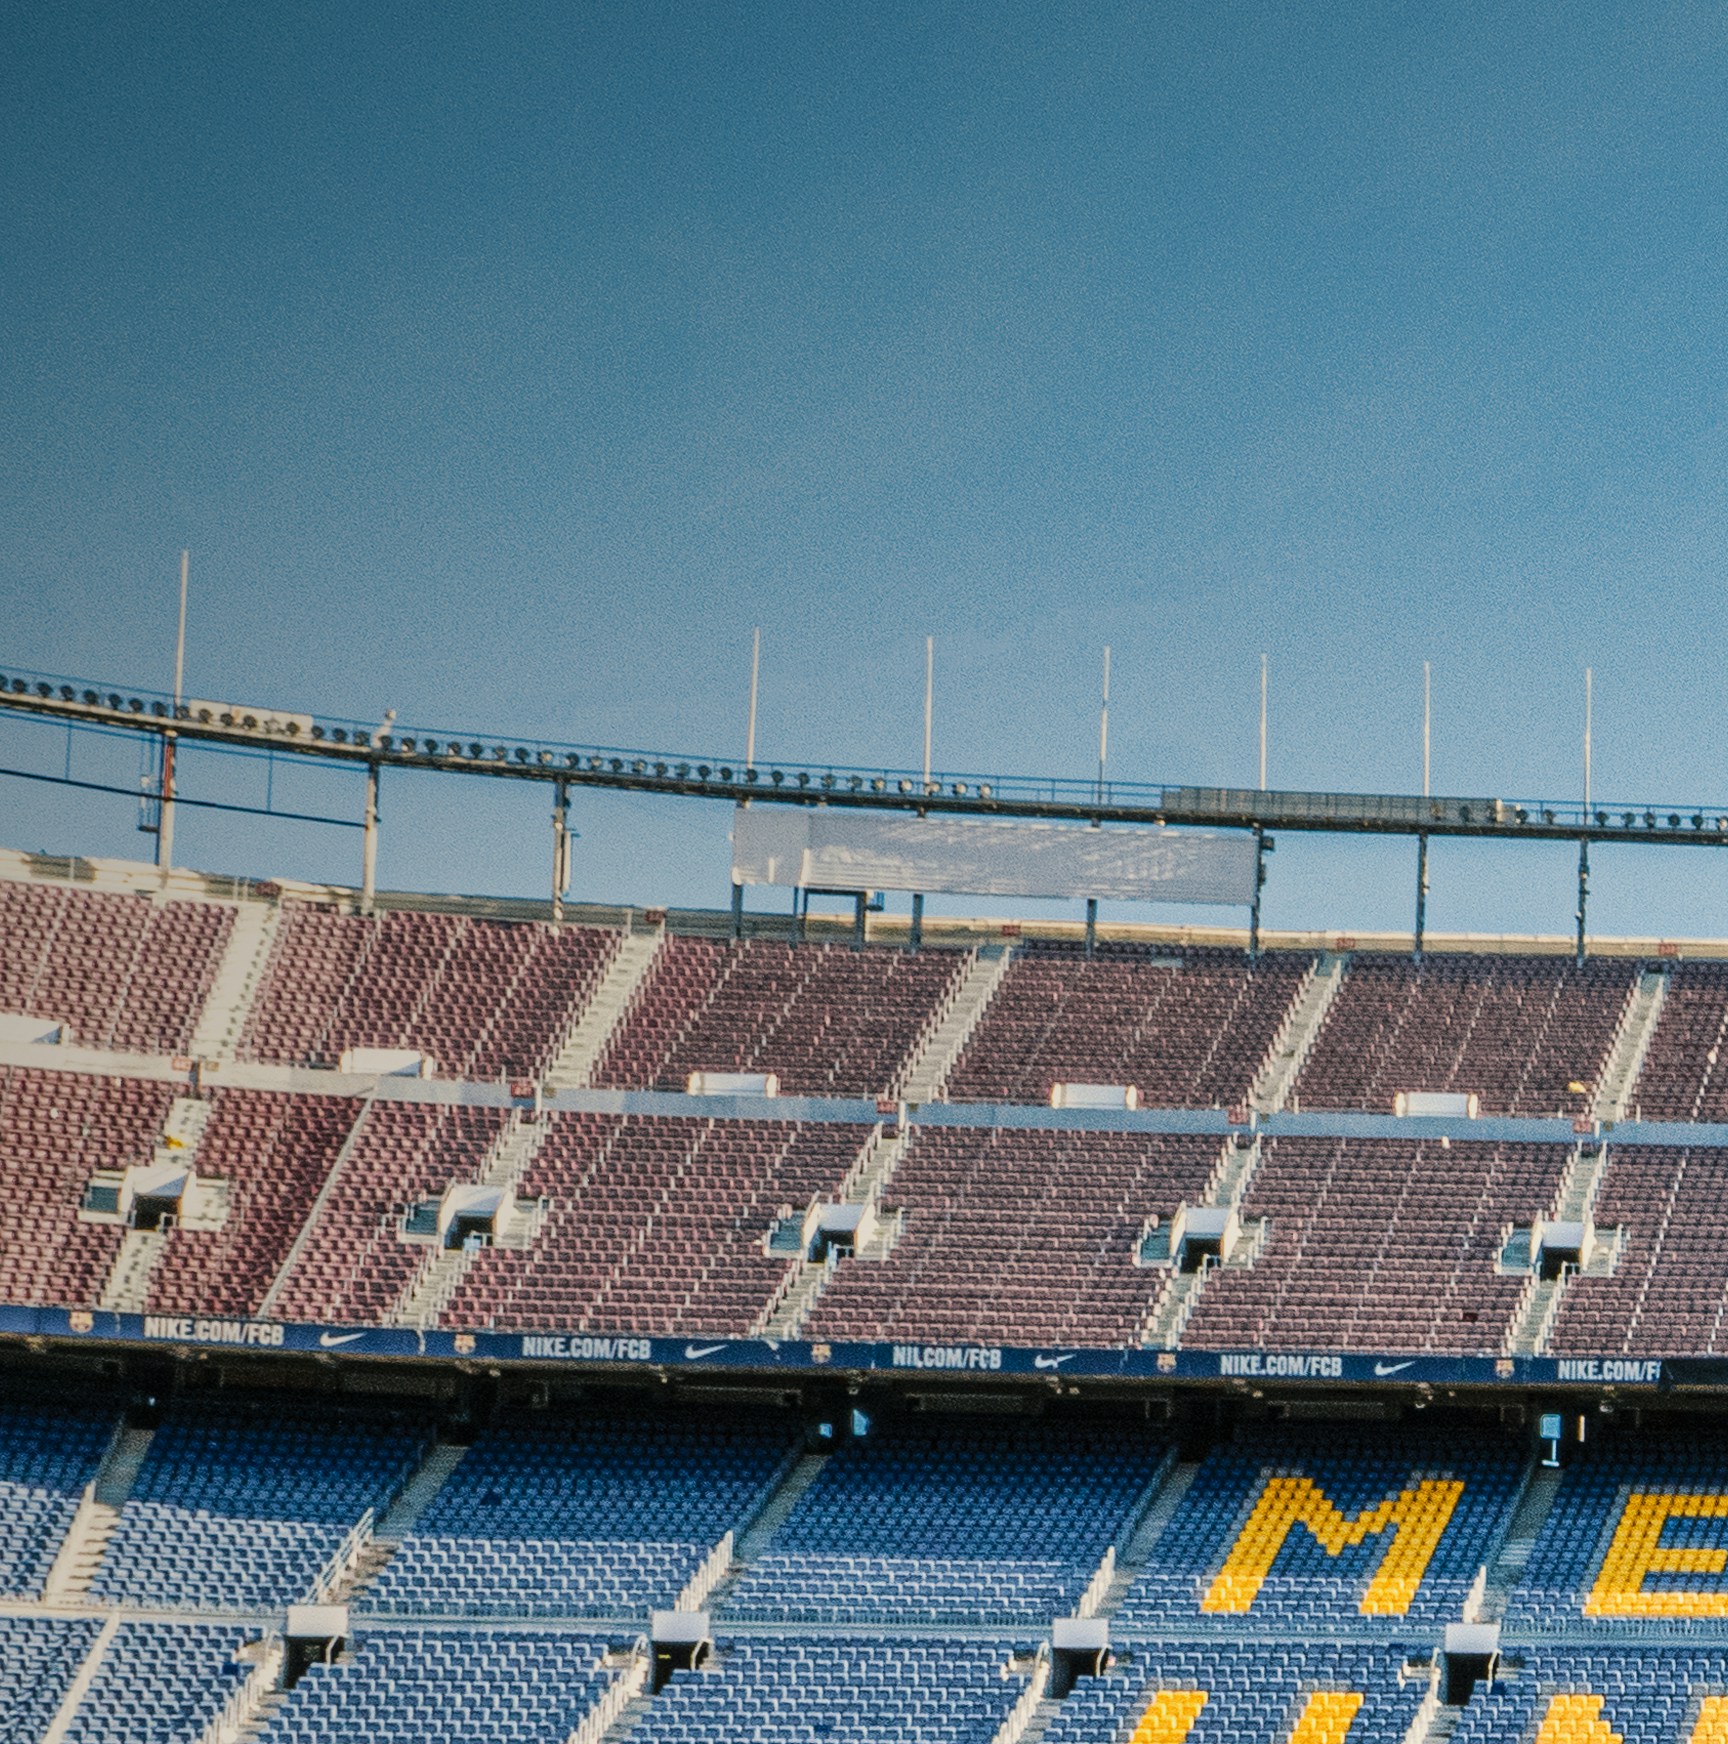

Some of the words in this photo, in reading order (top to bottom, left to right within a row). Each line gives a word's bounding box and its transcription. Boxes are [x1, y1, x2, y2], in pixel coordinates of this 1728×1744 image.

[144, 1315, 285, 1346] NIKE.COM/FCB
[522, 1336, 651, 1360] NIKE.COM/FCB
[1220, 1354, 1342, 1377] NIKE.COM/FCB
